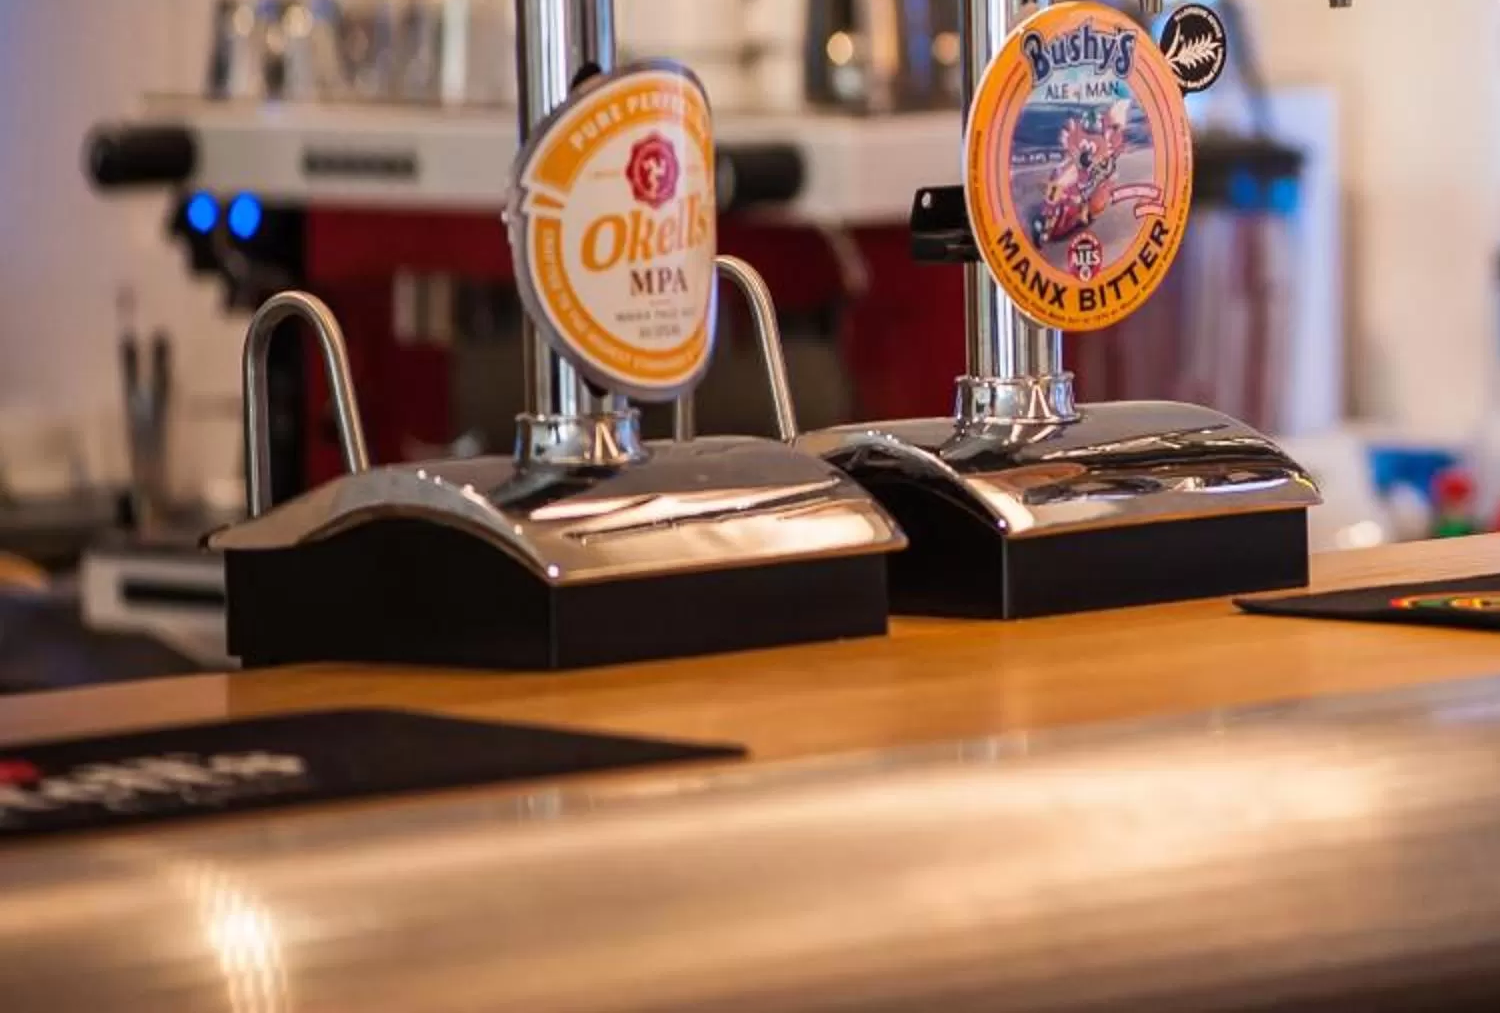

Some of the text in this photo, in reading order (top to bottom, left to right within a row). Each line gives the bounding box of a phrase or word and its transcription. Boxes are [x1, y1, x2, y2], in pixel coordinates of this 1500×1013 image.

[1085, 81, 1119, 98] MAN
[996, 226, 1067, 311] MANX
[1079, 218, 1169, 312] BITTER
[629, 266, 689, 296] MPA
